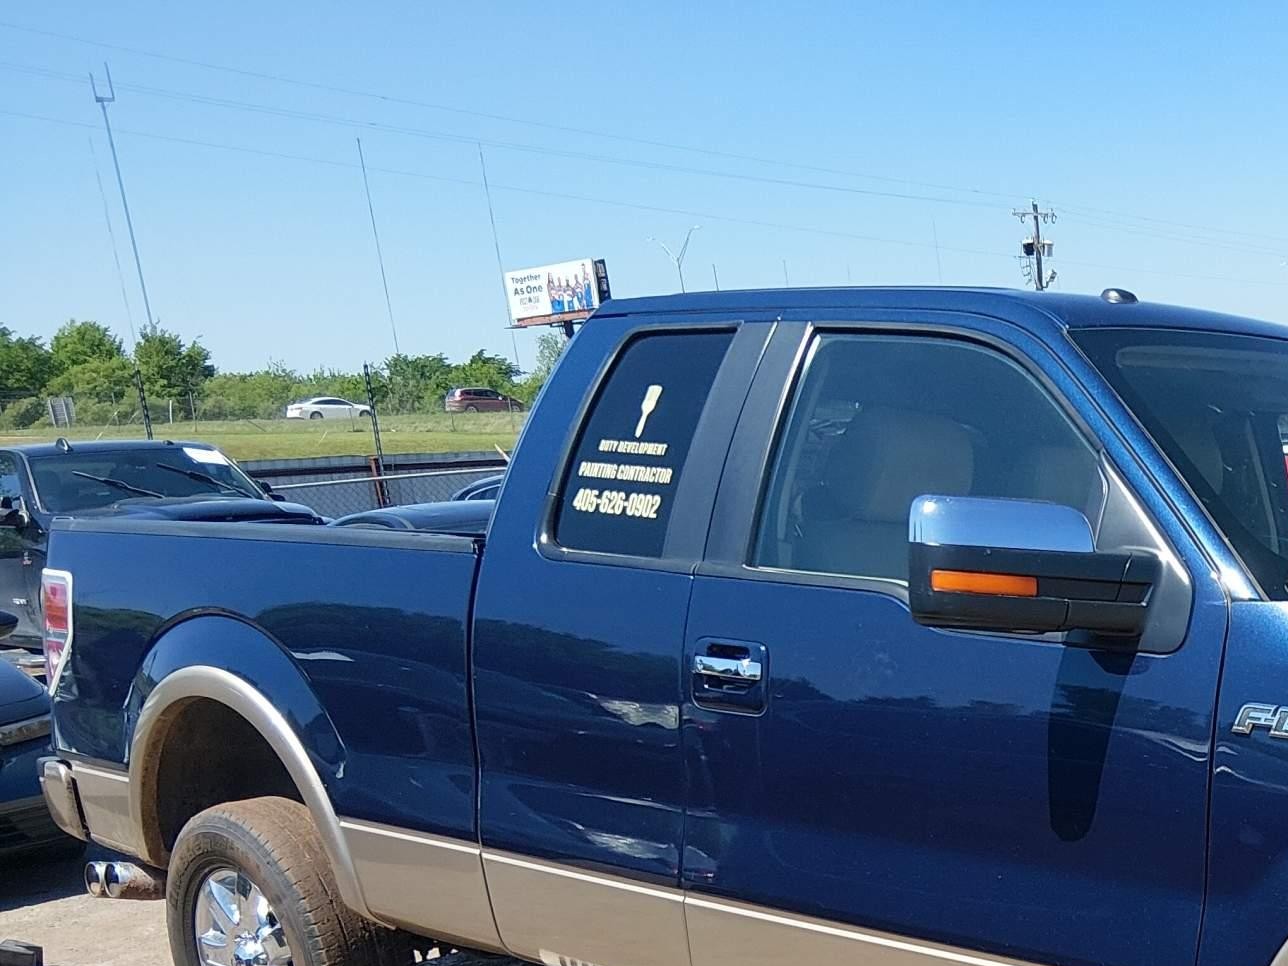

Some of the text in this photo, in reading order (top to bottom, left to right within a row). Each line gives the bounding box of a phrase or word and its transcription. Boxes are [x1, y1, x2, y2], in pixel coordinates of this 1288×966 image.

[511, 273, 541, 285] Together
[513, 284, 543, 296] As One
[617, 441, 668, 455] DEVELOPMENT
[578, 461, 673, 484] PAINTING CONTRACTOR
[573, 488, 661, 518] 405-626-0902
